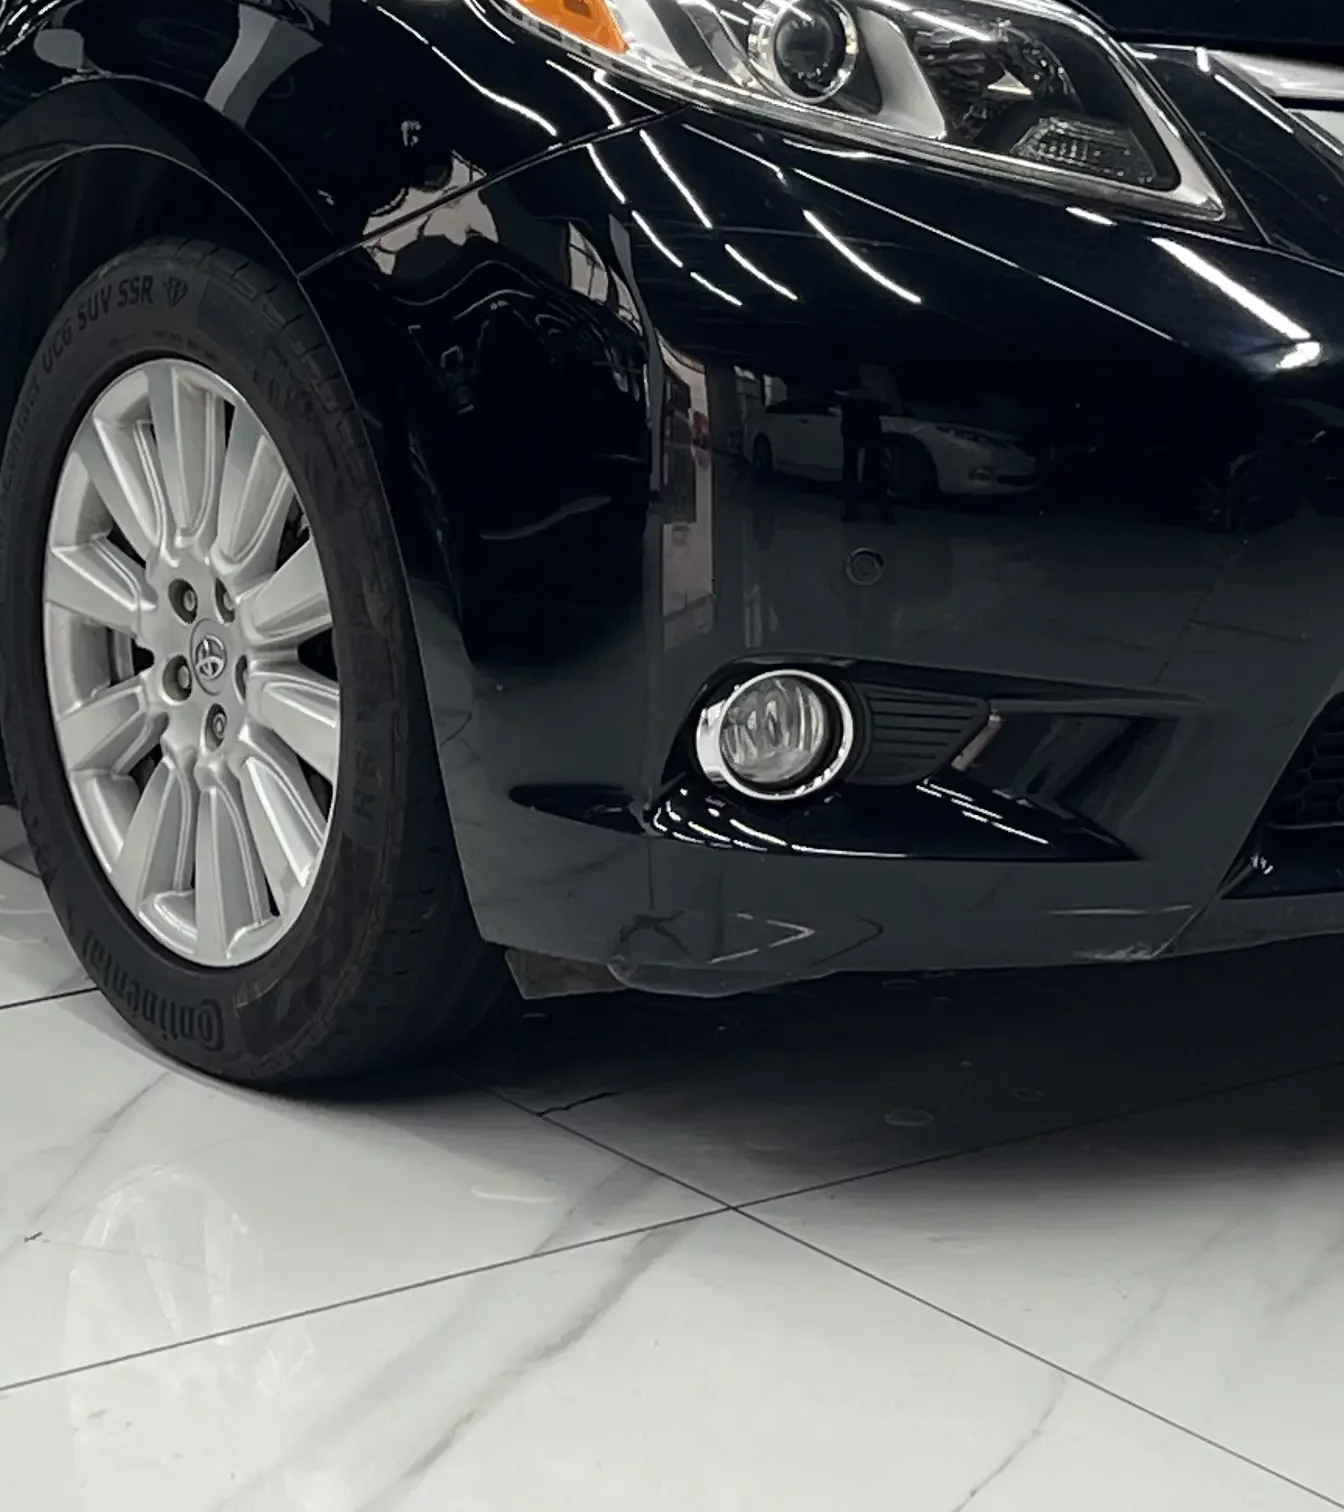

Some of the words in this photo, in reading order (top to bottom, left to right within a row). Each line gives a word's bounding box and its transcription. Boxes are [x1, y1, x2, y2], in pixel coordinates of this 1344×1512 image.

[77, 284, 112, 331] SUV
[117, 274, 154, 308] SSR
[81, 928, 226, 1053] Continental
